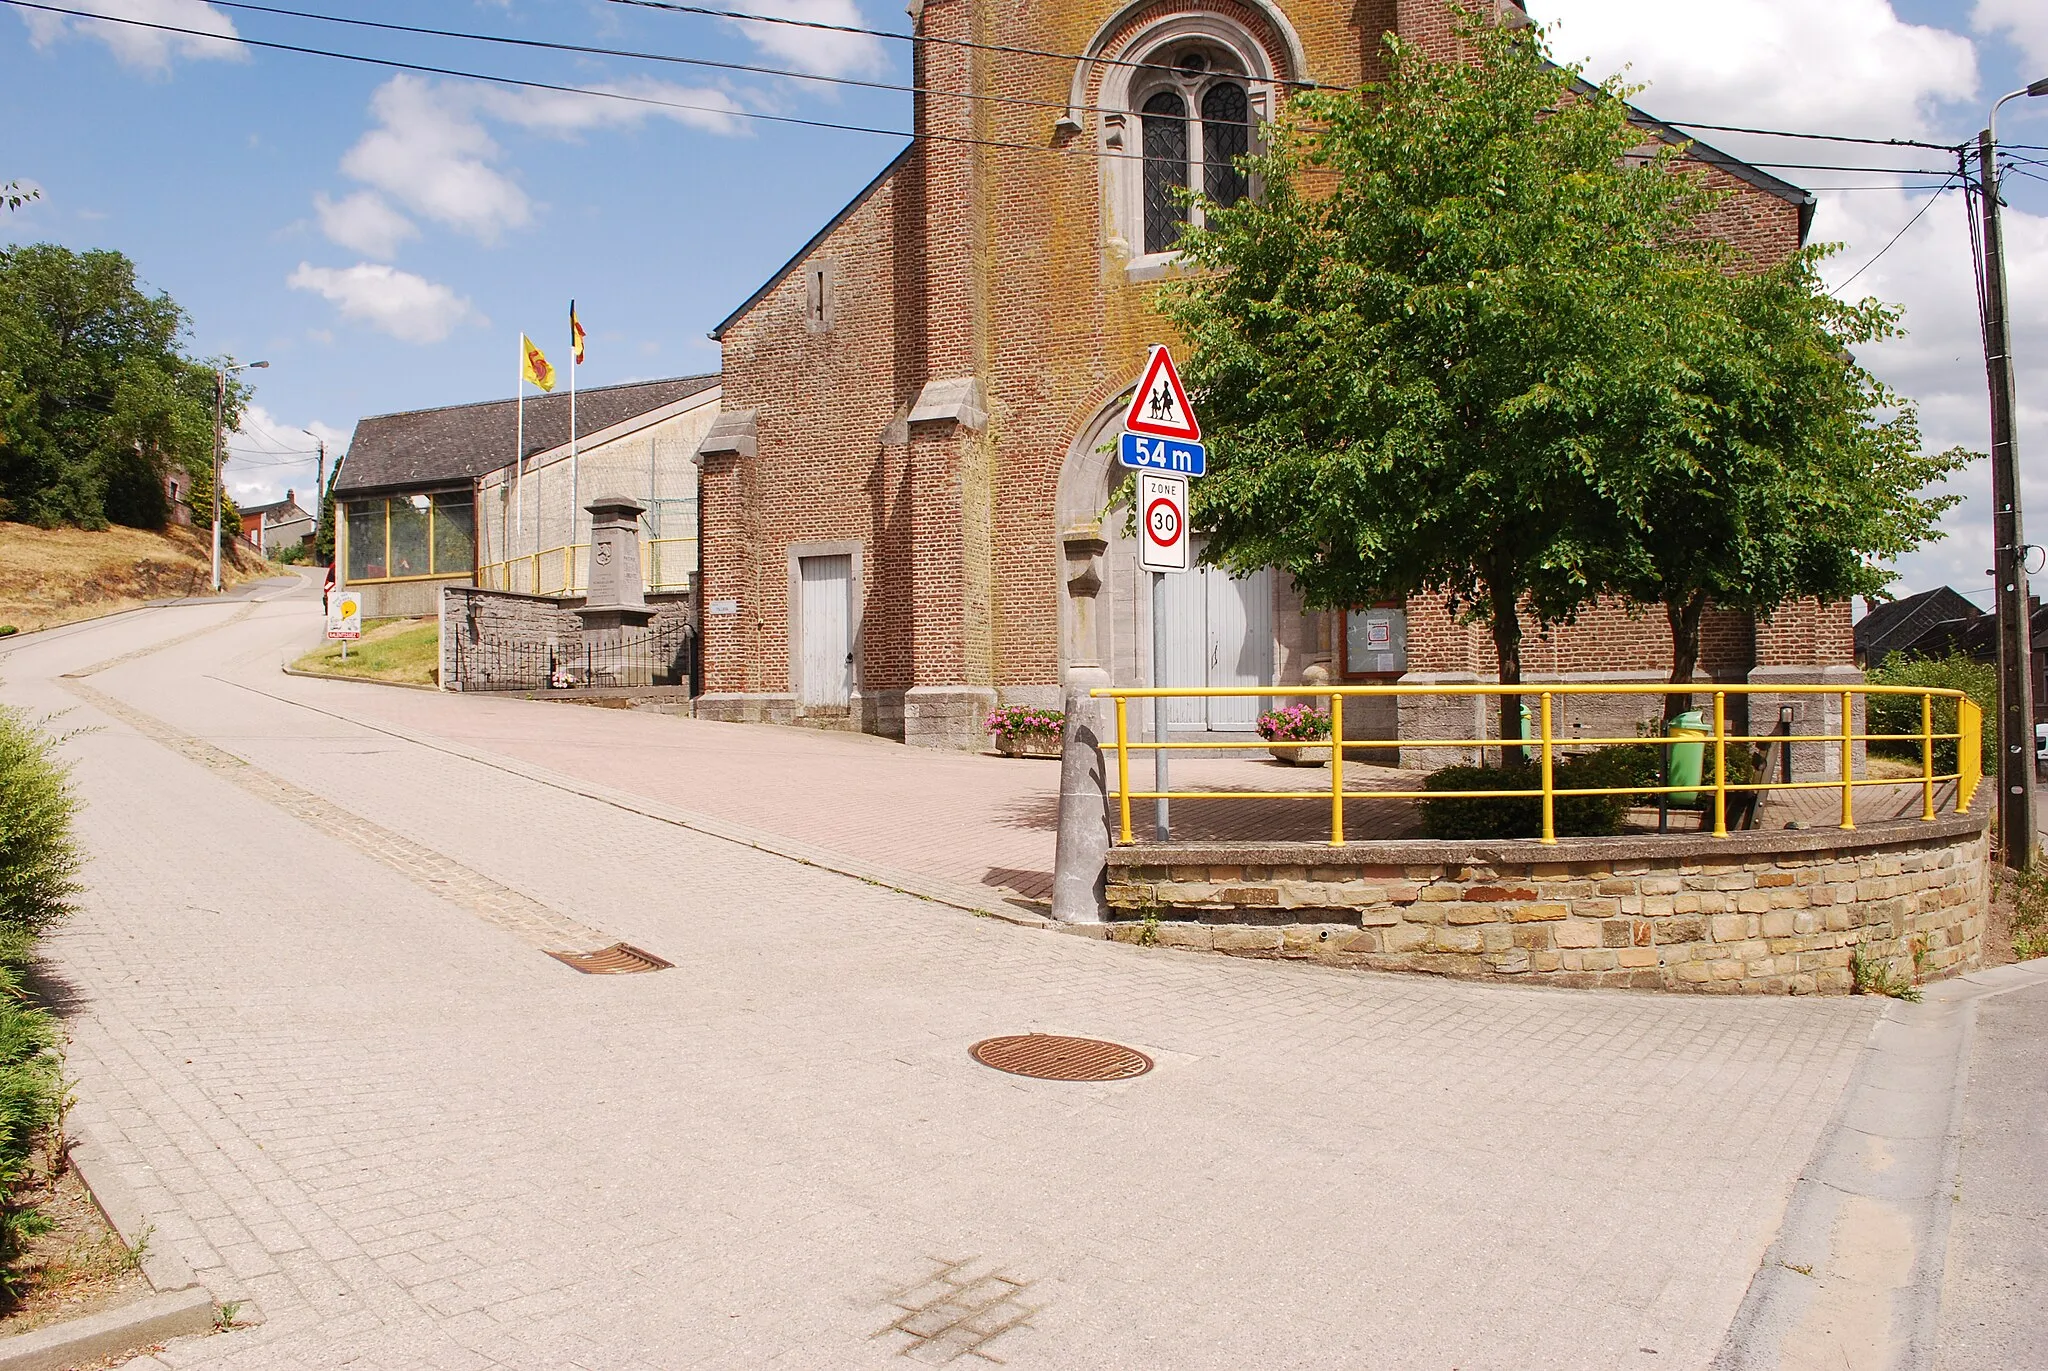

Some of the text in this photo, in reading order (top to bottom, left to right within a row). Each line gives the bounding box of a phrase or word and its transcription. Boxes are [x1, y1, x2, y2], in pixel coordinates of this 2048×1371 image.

[1136, 438, 1191, 471] 54 m
[1151, 483, 1176, 495] ZONE
[1154, 513, 1174, 531] 30
